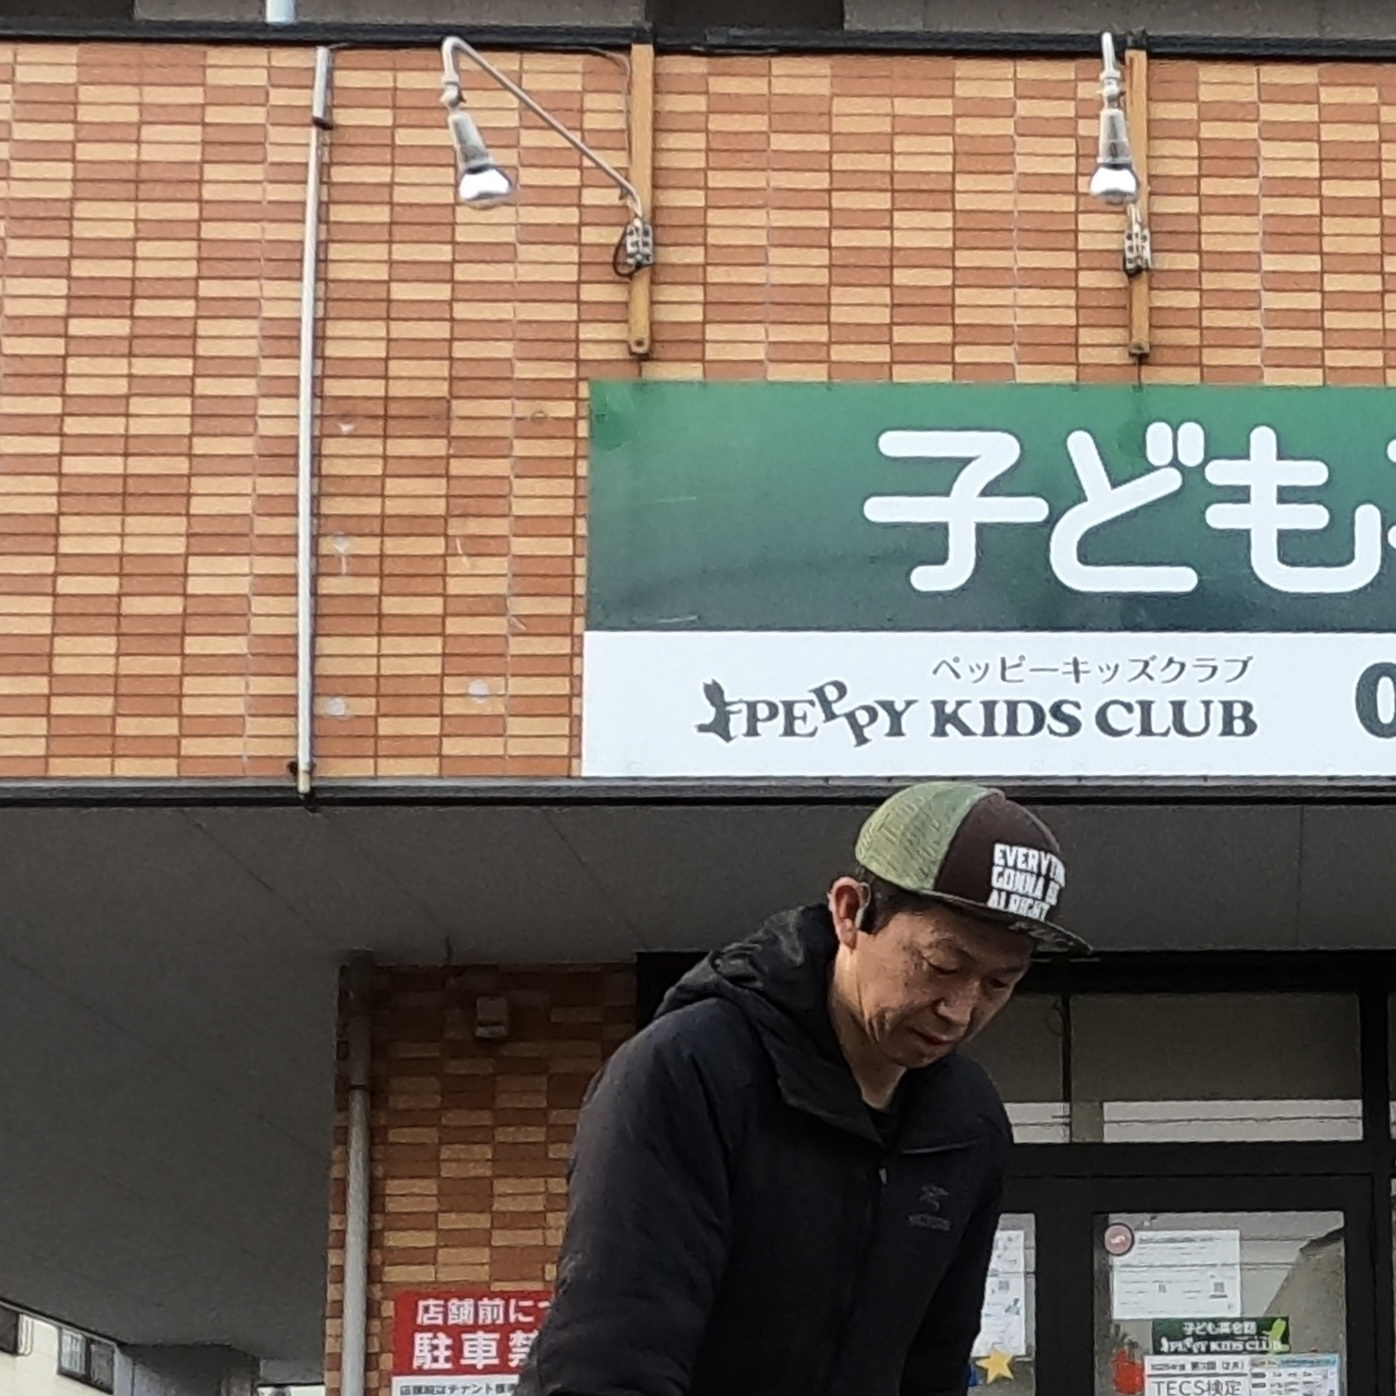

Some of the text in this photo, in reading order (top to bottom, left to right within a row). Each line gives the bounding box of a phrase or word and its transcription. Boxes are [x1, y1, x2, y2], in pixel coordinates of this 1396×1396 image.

[933, 655, 1254, 685] ペッピーキッズクラブ
[742, 680, 1257, 748] PEPPY KIDS CLUB
[991, 865, 1044, 898] GONNA
[987, 891, 1050, 922] ALRIGHT
[413, 1329, 539, 1370] 駐車禁
[1153, 1379, 1242, 1396] TECS検定
